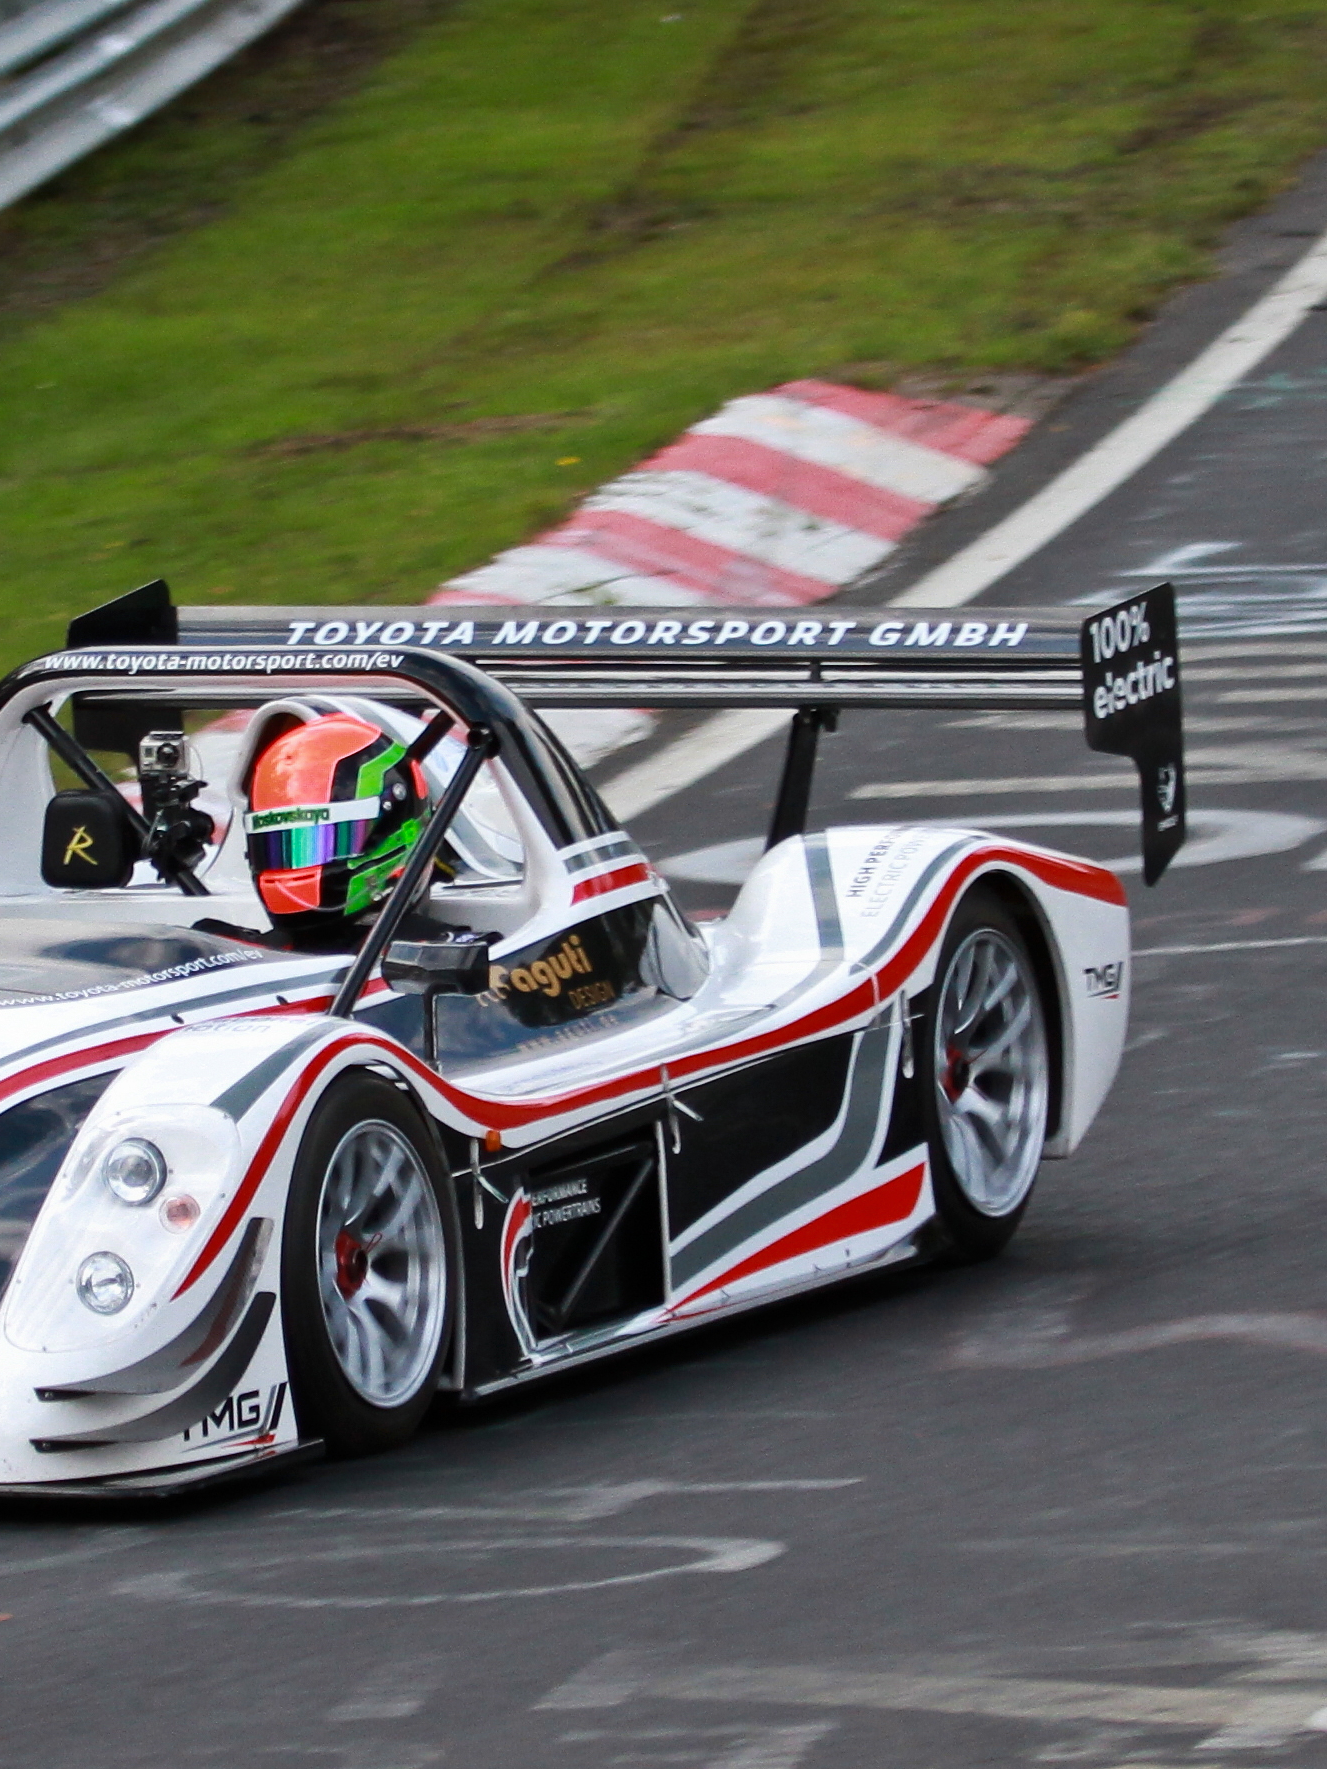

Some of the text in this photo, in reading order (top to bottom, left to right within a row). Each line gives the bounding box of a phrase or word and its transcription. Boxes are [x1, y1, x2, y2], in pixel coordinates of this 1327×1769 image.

[43, 650, 406, 675] www.toyota-motorsport.com/ev
[285, 620, 1029, 648] TOYOTA MOTORSPORT GMBH
[1088, 601, 1151, 664] 100%
[1093, 651, 1175, 720] electric
[509, 934, 594, 998] aguti
